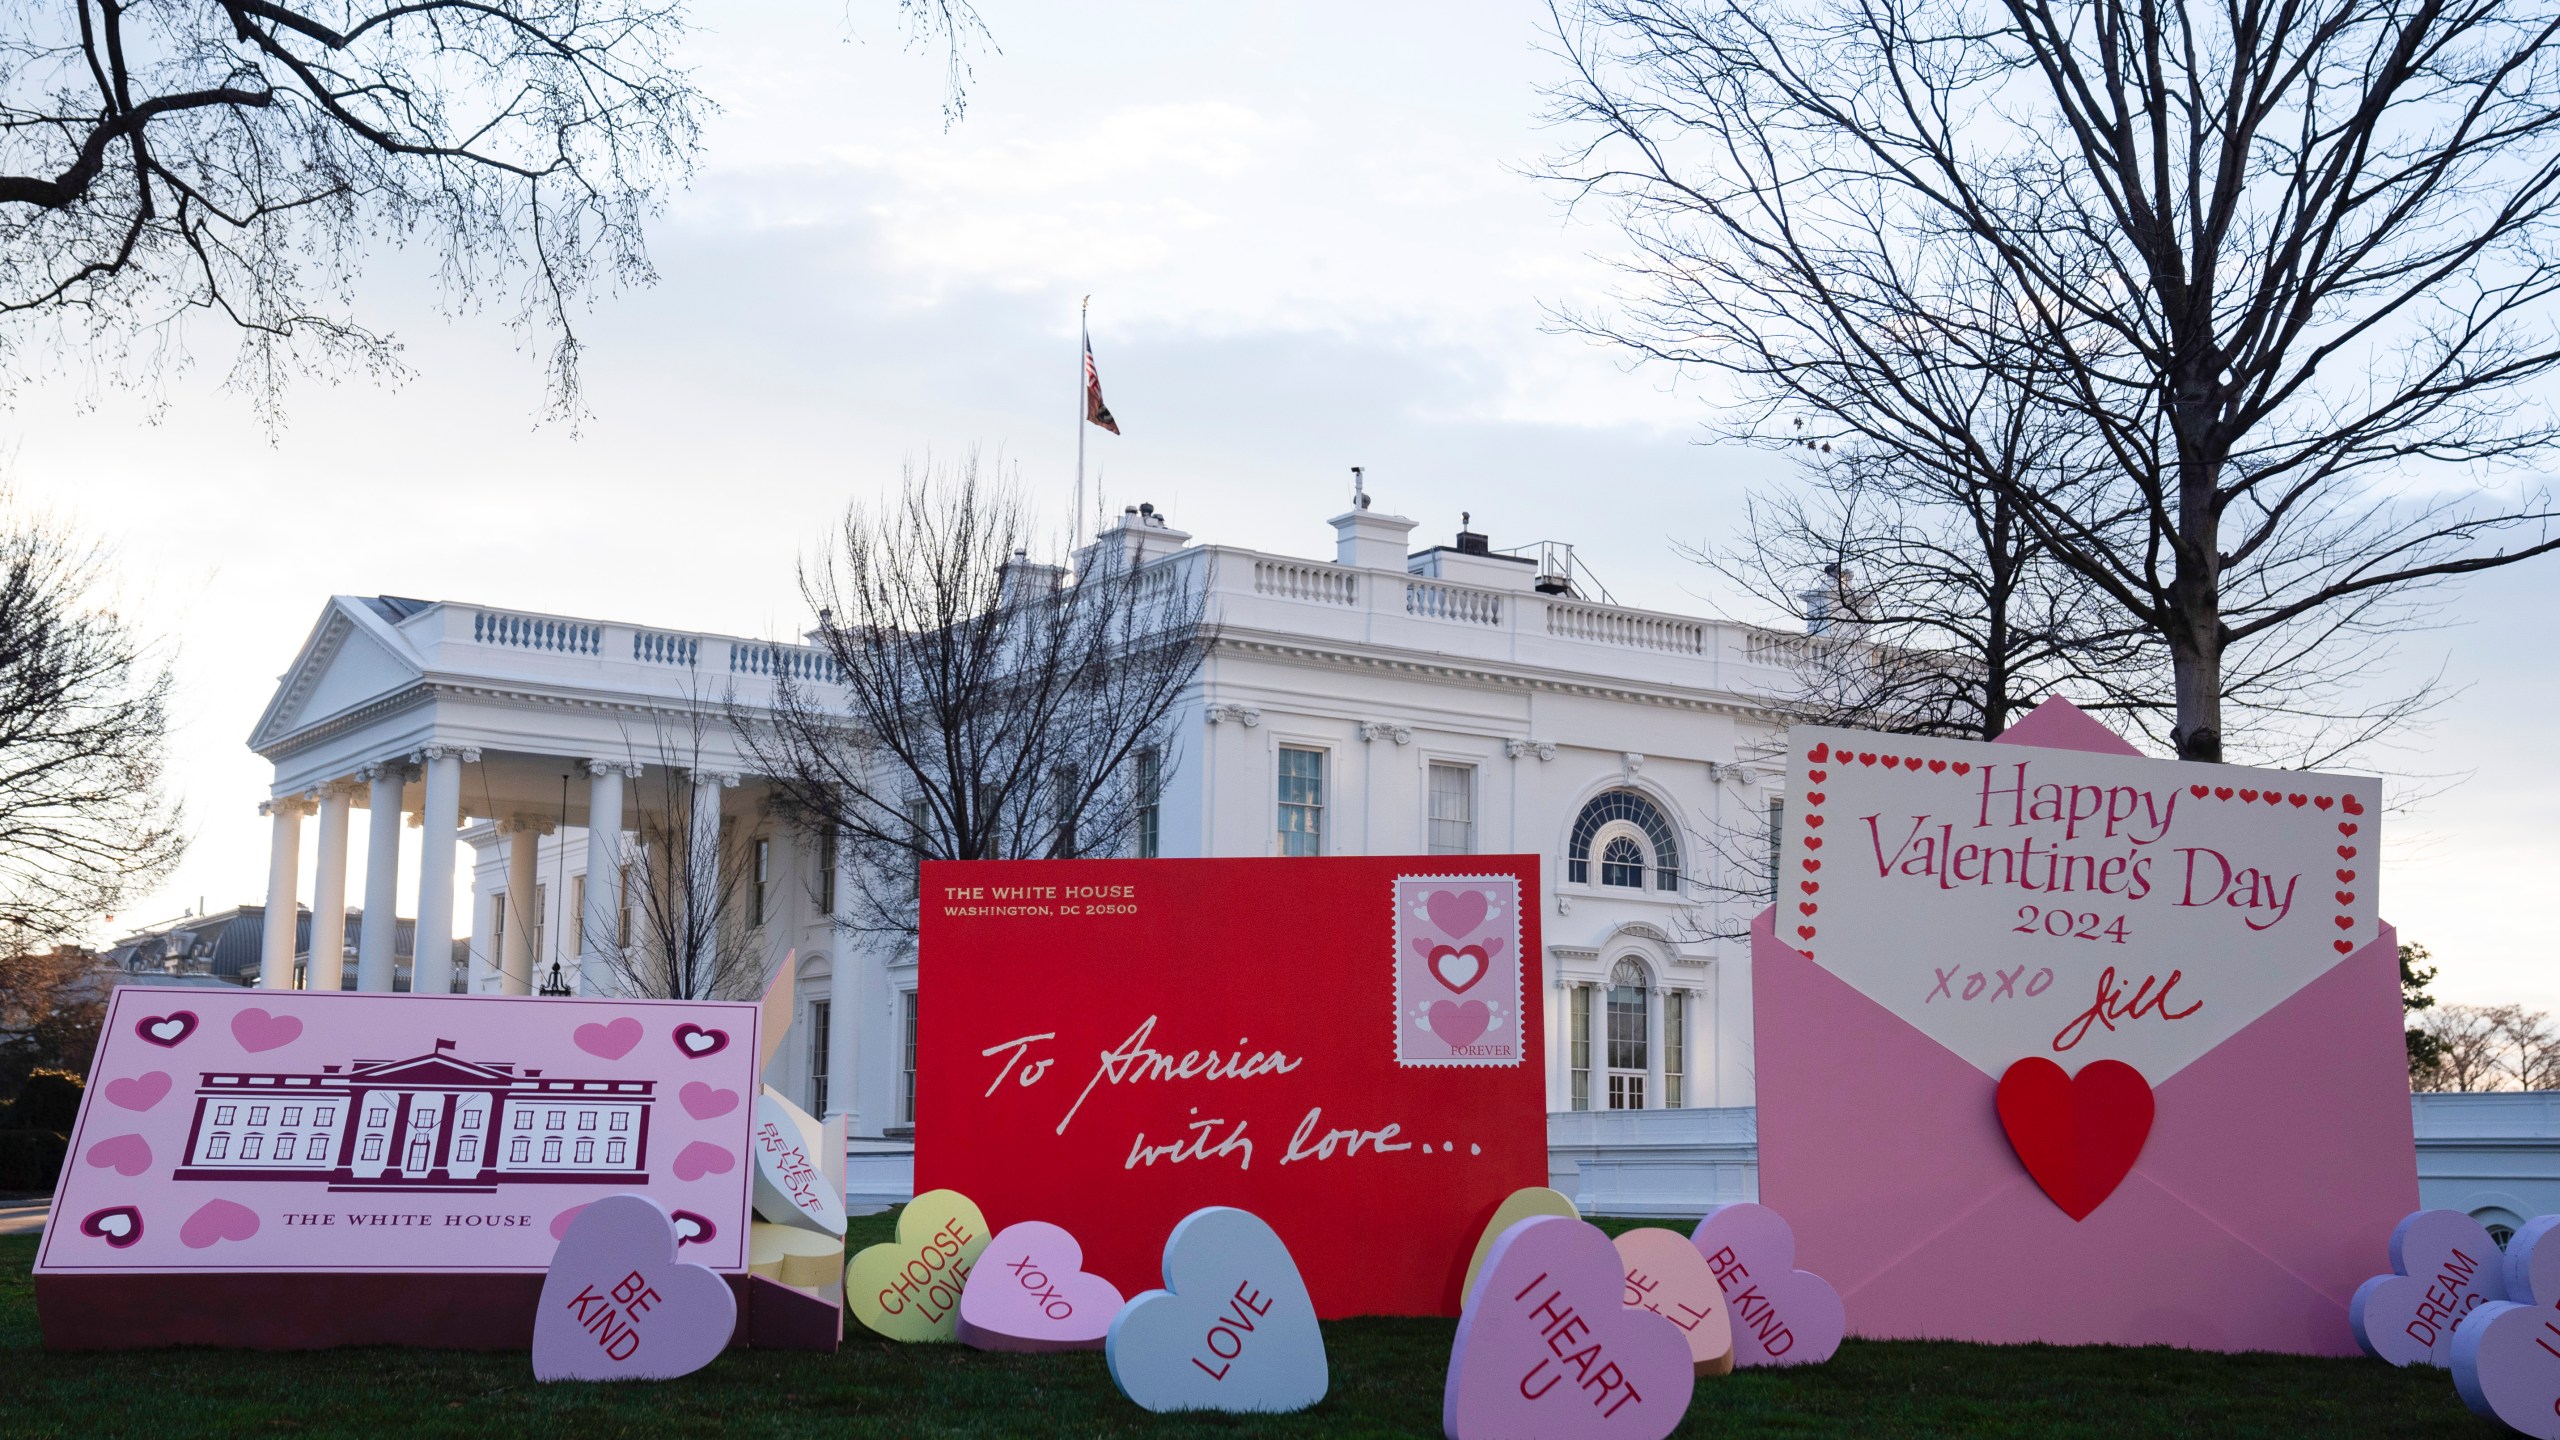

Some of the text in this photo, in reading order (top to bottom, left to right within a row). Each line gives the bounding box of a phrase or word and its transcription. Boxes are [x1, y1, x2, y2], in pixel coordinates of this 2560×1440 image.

[1974, 761, 2183, 845] Happy
[944, 904, 1137, 917] WASHINGTON, DC 20500
[945, 885, 1135, 900] THE WHITE HOUSE
[1860, 813, 2302, 931] Valentine's Day
[2012, 904, 2133, 944] 2024
[2052, 966, 2203, 1051] Jill
[983, 1015, 1302, 1135] To America
[1450, 1045, 1512, 1056] FOREVER
[757, 1131, 809, 1208] IN YOU
[764, 1123, 823, 1213] BELIEVE
[791, 1146, 818, 1182] WE
[1125, 1107, 1481, 1170] with love...
[283, 1214, 532, 1227] THE WHITE HOUSE
[610, 1270, 662, 1323] BE
[879, 1217, 973, 1315] CHOOSE
[1006, 1255, 1073, 1320] XOXO
[1707, 1246, 1794, 1357] BE KIND
[2405, 1248, 2479, 1348] DREAM
[566, 1284, 640, 1361] KIND
[1192, 1280, 1273, 1382] LOVE
[1514, 1272, 1643, 1419] I HEART
[1520, 1358, 1562, 1400] U
